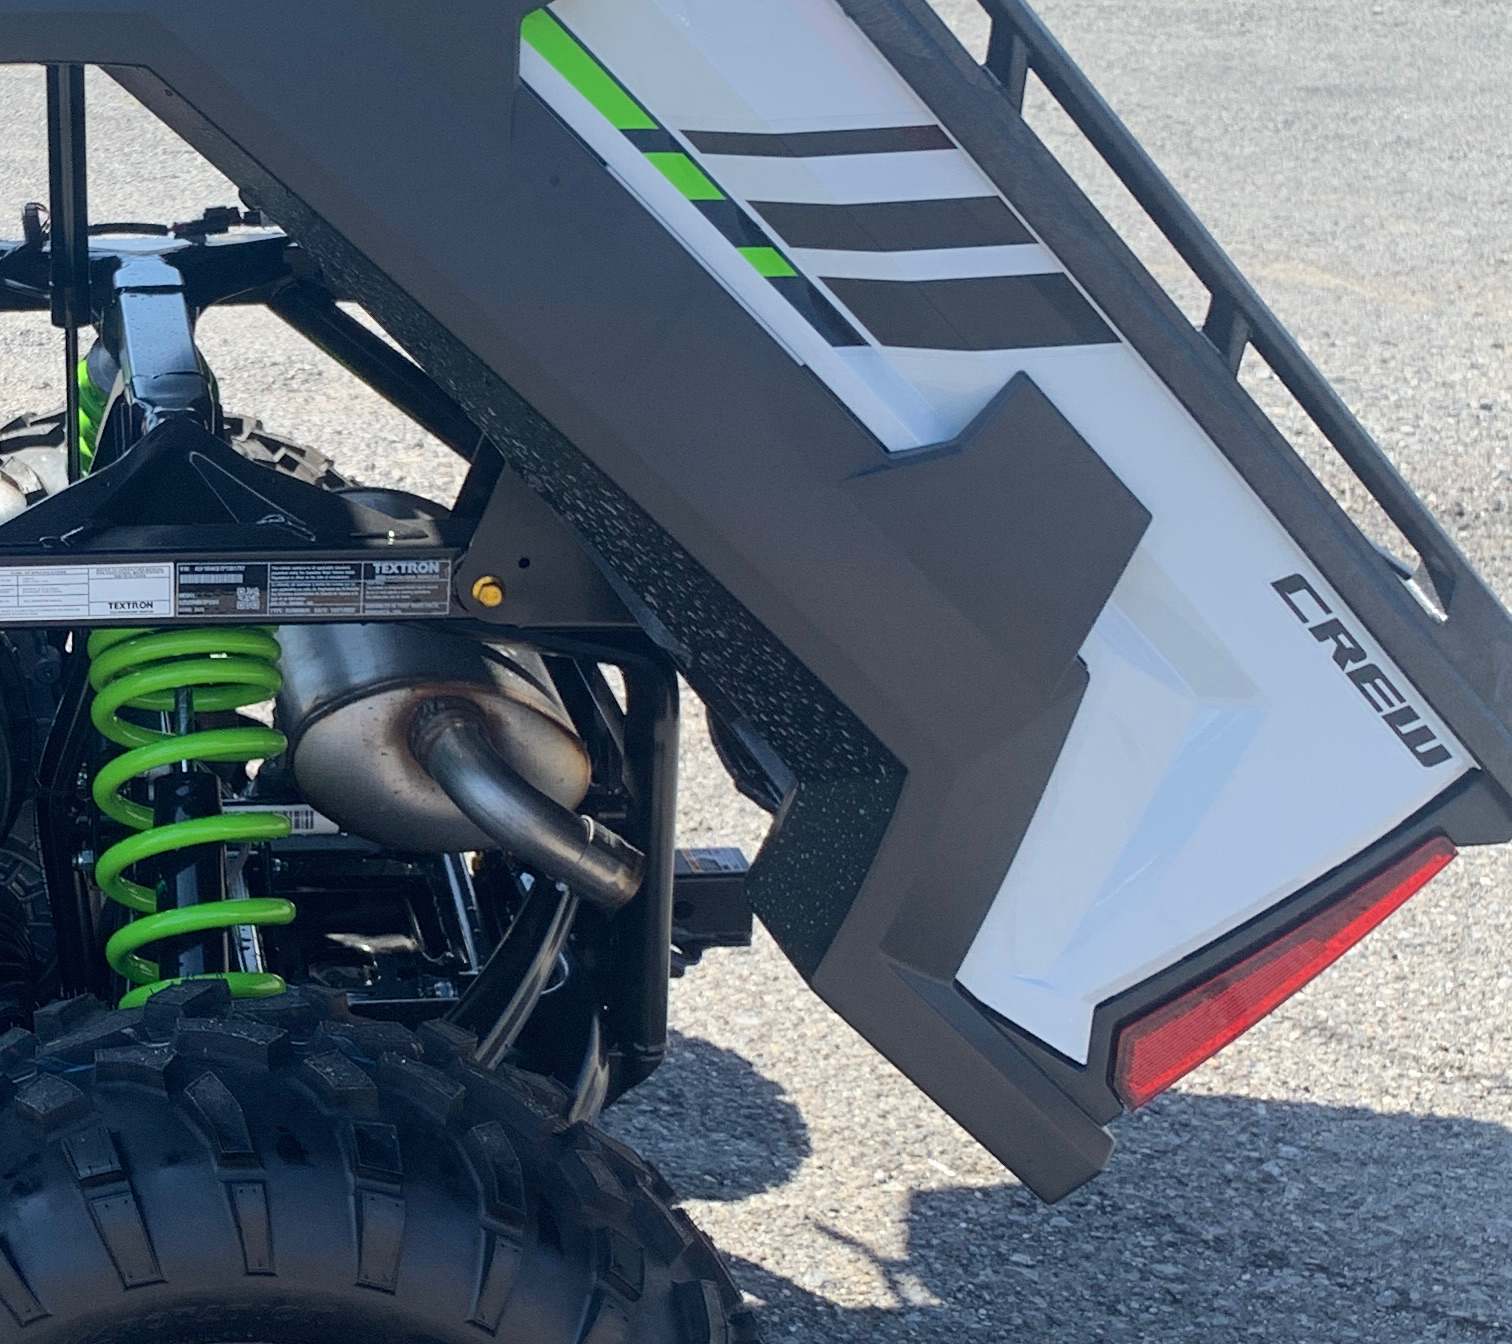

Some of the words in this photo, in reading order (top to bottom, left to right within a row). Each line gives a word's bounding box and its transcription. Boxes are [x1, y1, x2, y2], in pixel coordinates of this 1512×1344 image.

[373, 560, 440, 574] TEXTRON
[108, 601, 153, 610] TEXTRON
[1270, 573, 1453, 767] CREW
